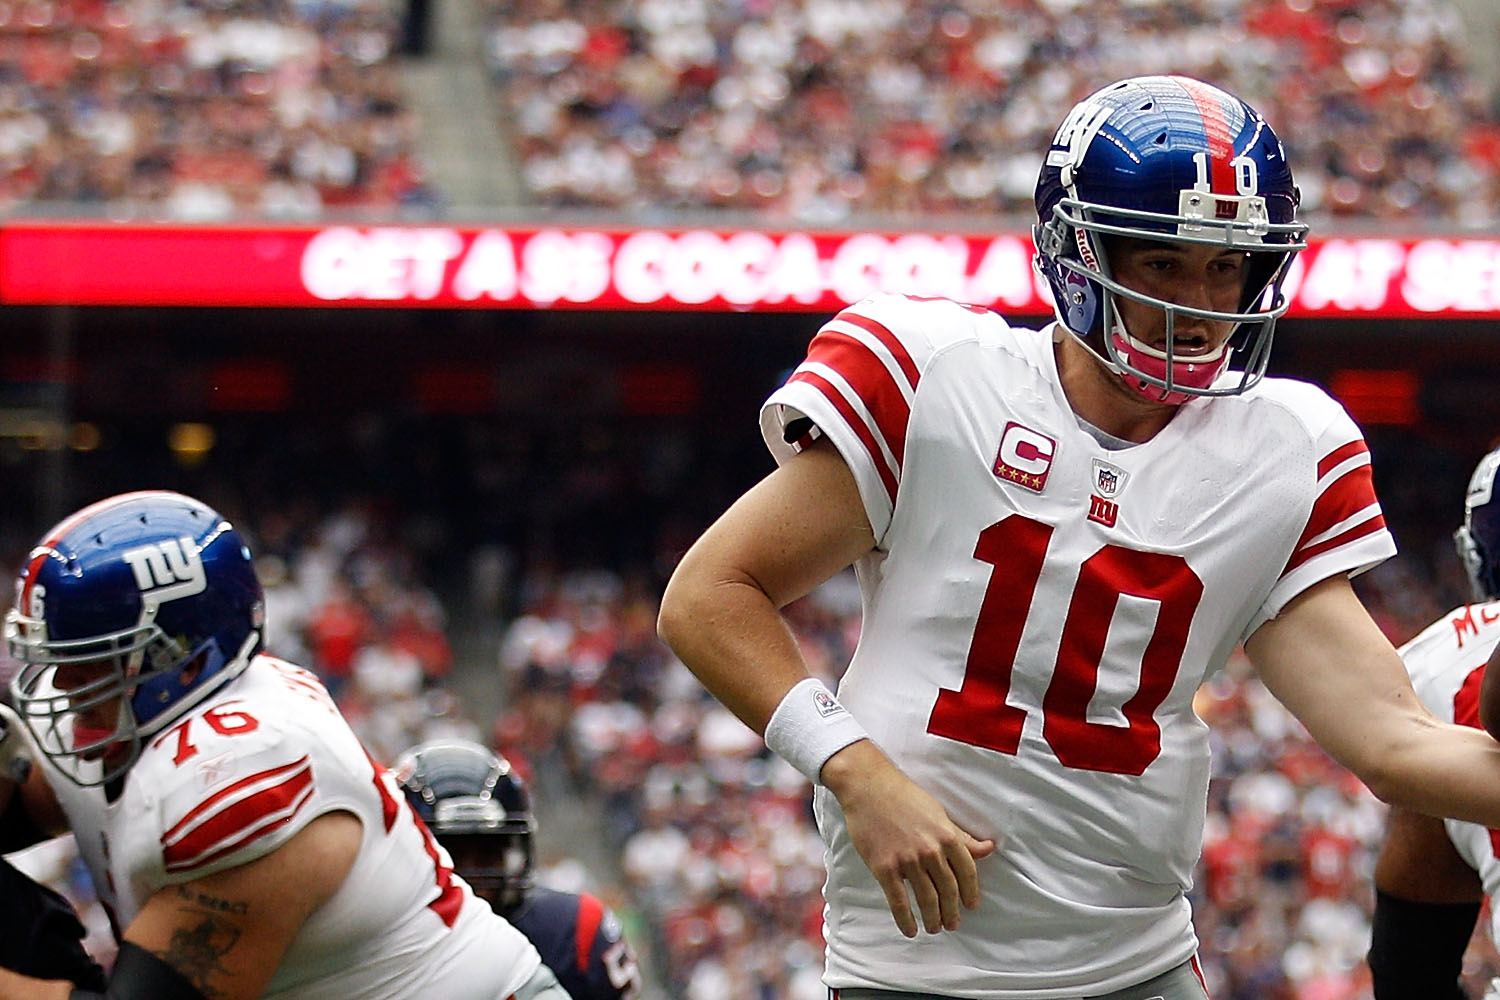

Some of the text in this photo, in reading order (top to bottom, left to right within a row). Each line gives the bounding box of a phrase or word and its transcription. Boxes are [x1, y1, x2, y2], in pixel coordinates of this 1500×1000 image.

[302, 227, 464, 300] GET
[453, 229, 519, 301] A
[612, 230, 1033, 307] COCA-COLA
[1302, 240, 1405, 311] AT
[1000, 426, 1055, 475] C
[926, 513, 1205, 776] 10
[153, 700, 260, 767] 76
